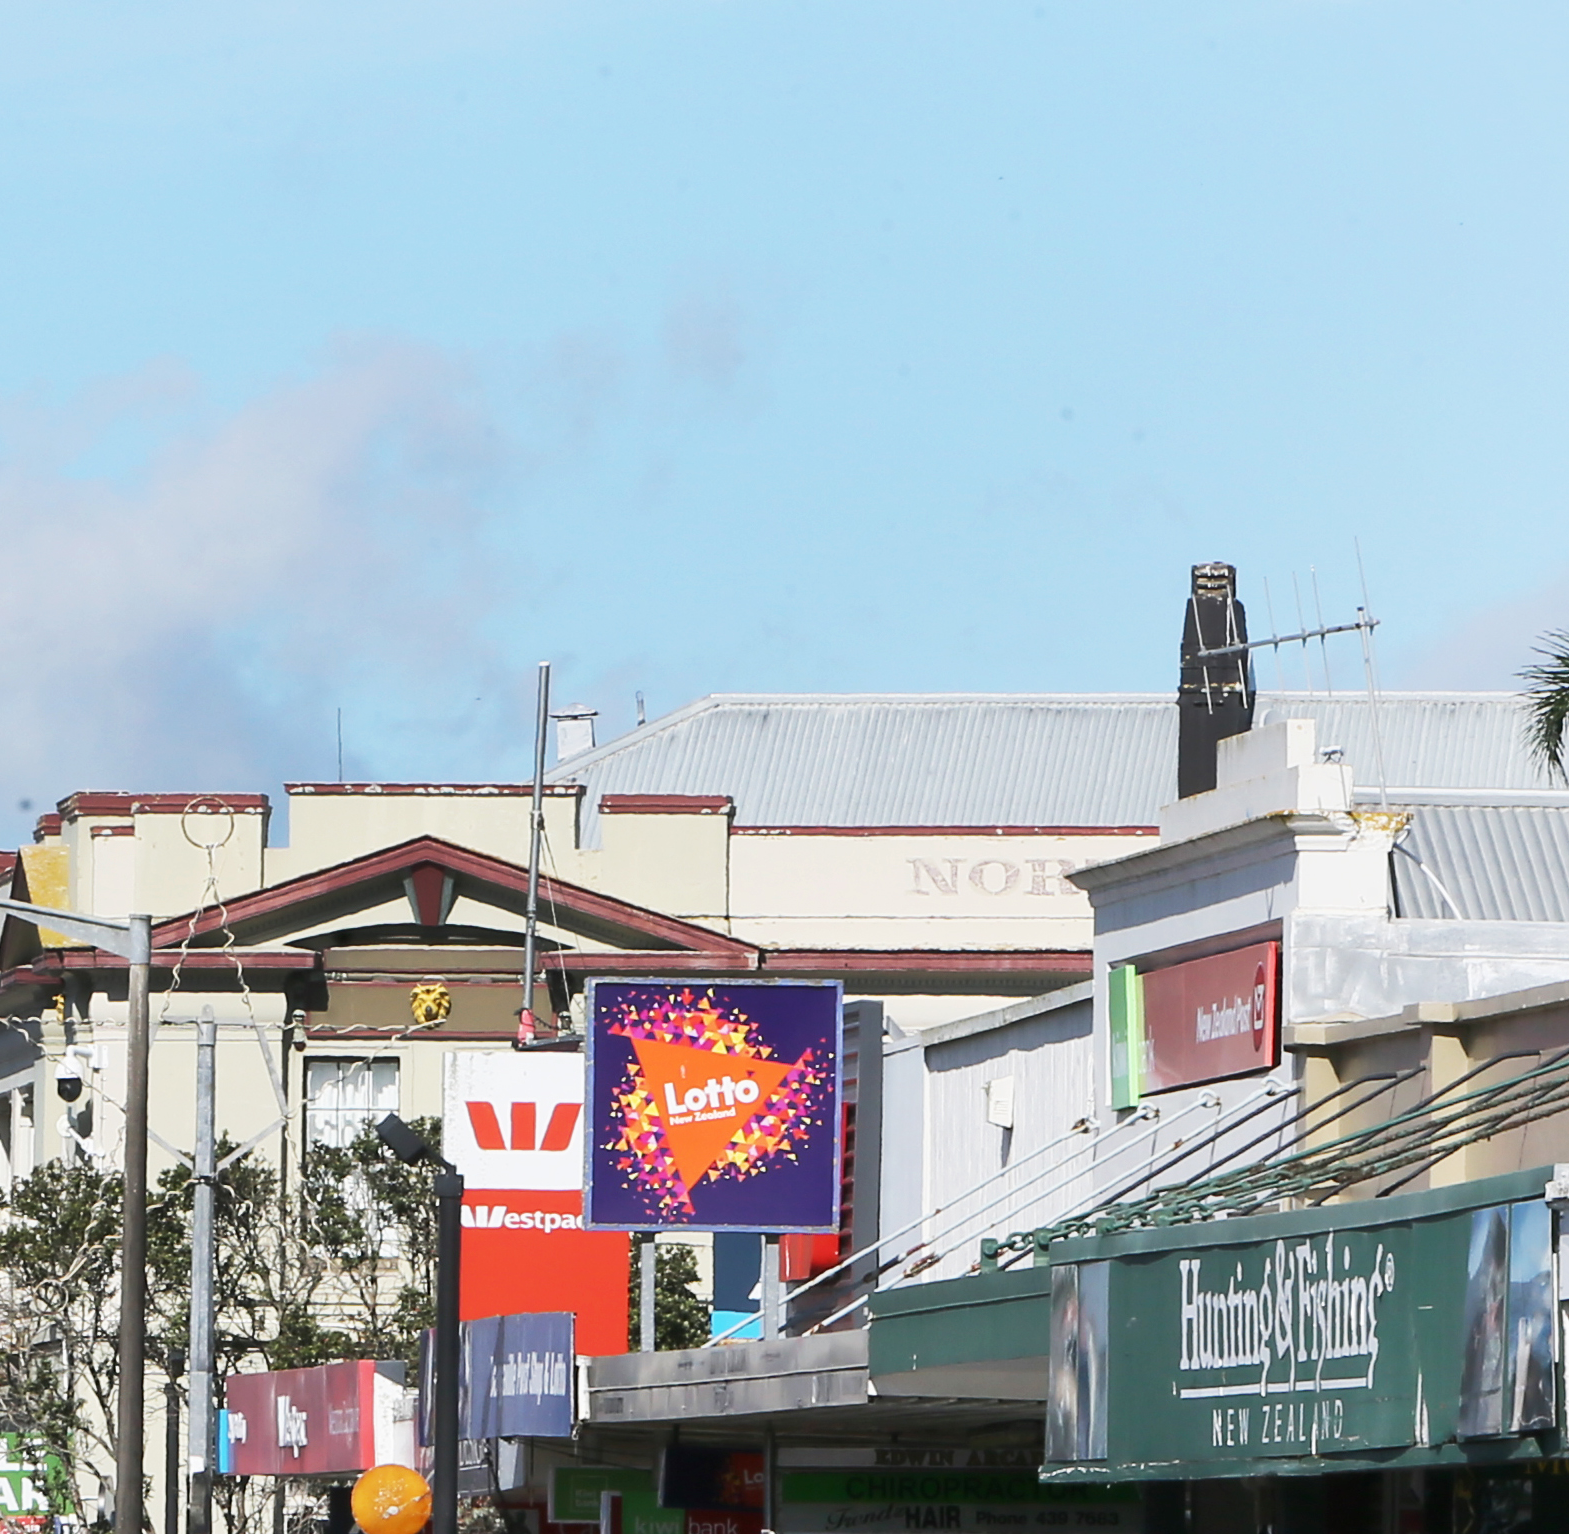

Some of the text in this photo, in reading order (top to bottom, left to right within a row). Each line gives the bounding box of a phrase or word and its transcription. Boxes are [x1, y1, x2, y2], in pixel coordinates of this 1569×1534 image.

[906, 858, 1095, 896] NOR
[664, 1076, 759, 1114] Lotto
[669, 1106, 736, 1126] New Zealand
[1179, 1257, 1272, 1397] Hunting
[1213, 1399, 1344, 1446] NEW ZEALAND
[874, 1449, 954, 1466] EDWIN
[845, 1475, 1090, 1500] CHIROPRACTOR
[906, 1505, 960, 1529] HAIR
[976, 1511, 1027, 1525] Phone
